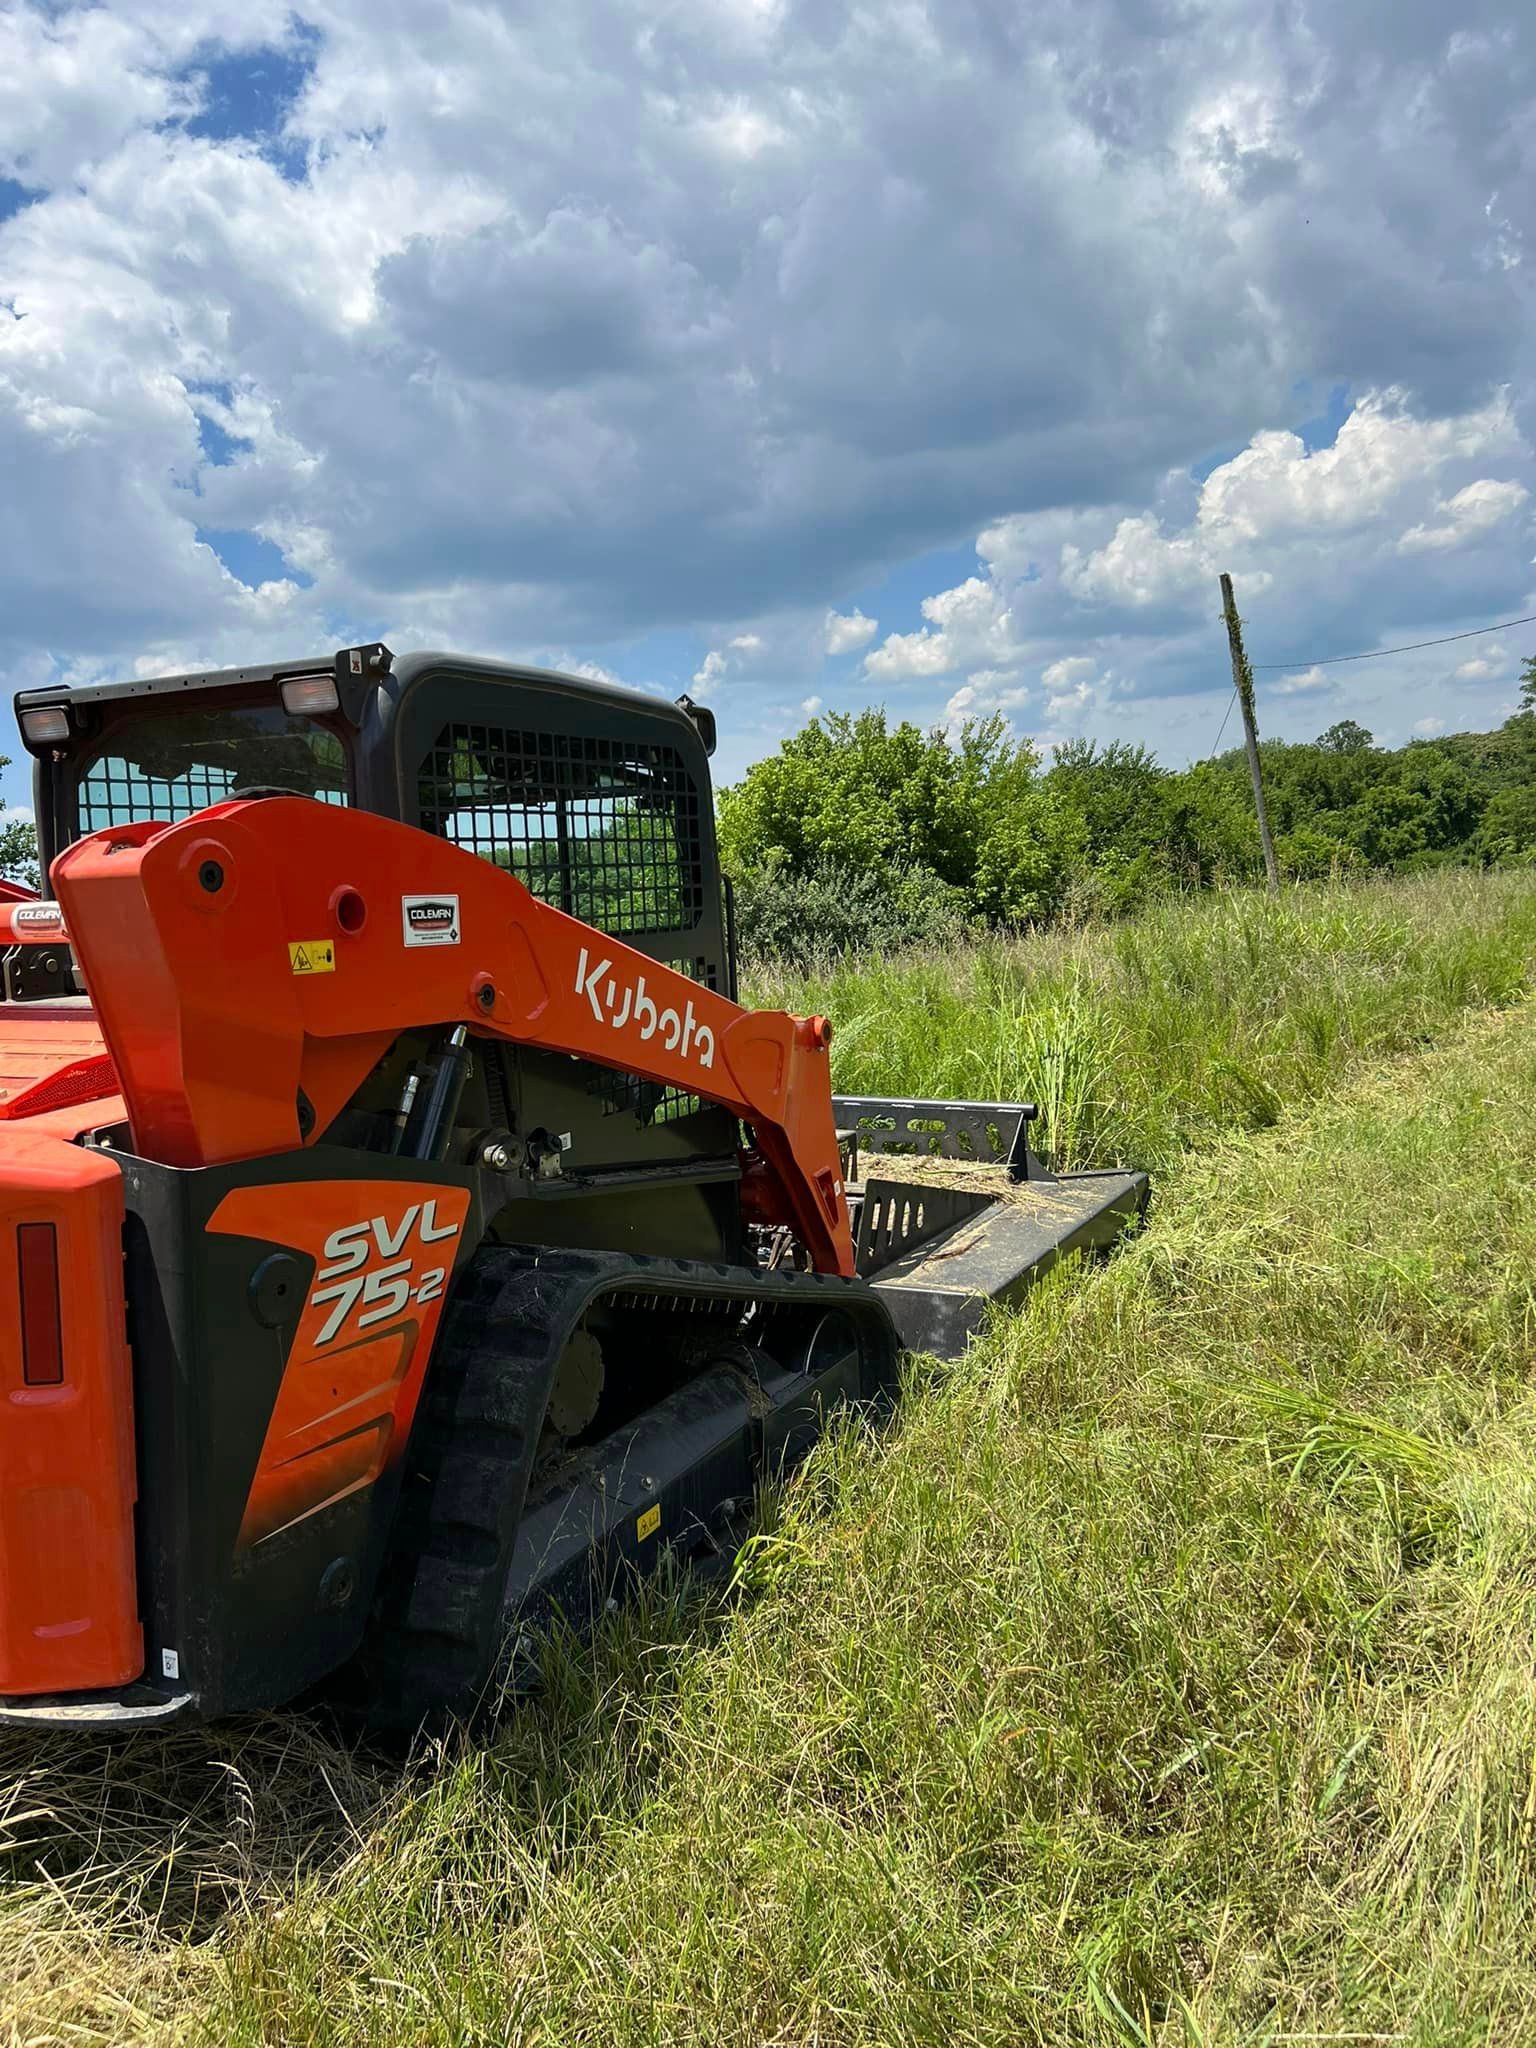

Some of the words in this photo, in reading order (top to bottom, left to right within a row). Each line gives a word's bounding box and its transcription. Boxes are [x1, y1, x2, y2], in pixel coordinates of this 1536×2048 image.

[18, 910, 60, 920] COLEMAN
[410, 908, 452, 920] COLEMAN
[575, 947, 714, 1069] Kubota
[318, 1200, 458, 1281] SVL
[311, 1259, 445, 1346] 75-2
